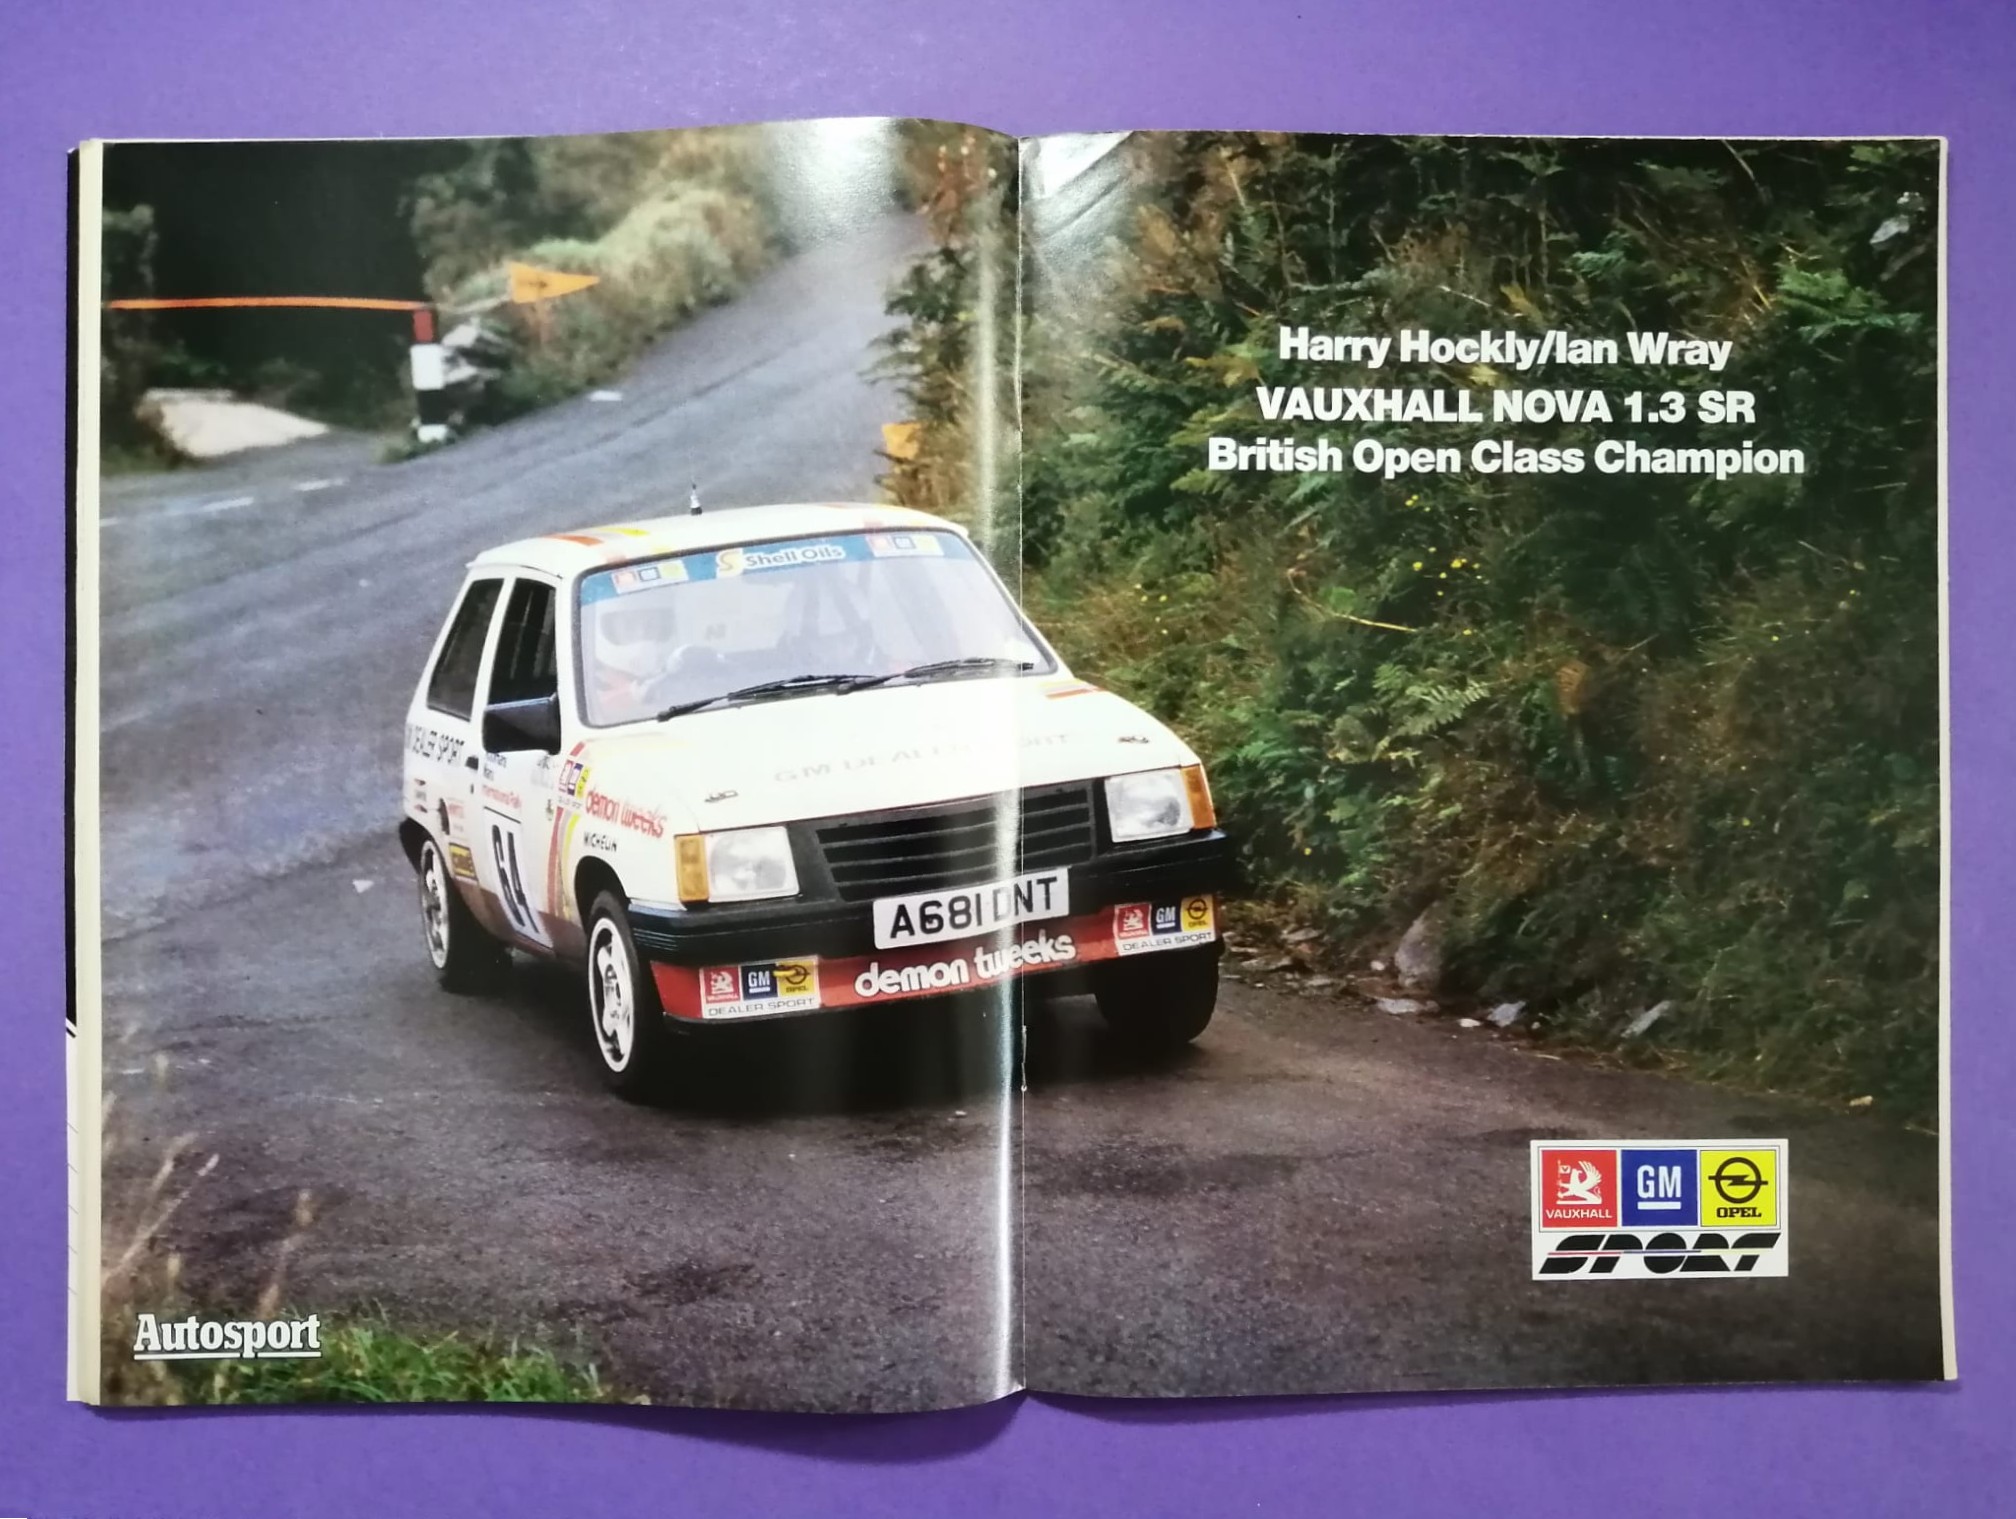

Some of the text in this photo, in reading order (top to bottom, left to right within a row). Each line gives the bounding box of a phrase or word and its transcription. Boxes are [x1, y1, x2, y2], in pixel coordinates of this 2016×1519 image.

[1280, 326, 1732, 370] Harry Hockly/Ian Wray
[1256, 386, 1755, 423] VAUXHALL NOVA 1.3 SR
[1209, 437, 1804, 480] British Open Class Champion
[745, 546, 843, 568] Shell Oils
[774, 763, 831, 783] GM
[585, 786, 667, 839] demon tweeks
[583, 831, 618, 852] MICHELIN
[889, 876, 1058, 940] A681 DNT
[1155, 905, 1176, 924] GM
[1122, 931, 1212, 952] DEALER SPORT
[854, 929, 1077, 998] demon tweeks
[747, 970, 771, 988] GM
[708, 997, 815, 1018] DEALER SPORT
[1636, 1164, 1682, 1199] GM
[1545, 1209, 1613, 1220] VAUXHALL
[1715, 1206, 1763, 1219] OPEL
[1538, 1231, 1782, 1275] SPORT
[133, 1313, 321, 1359] Autosport
